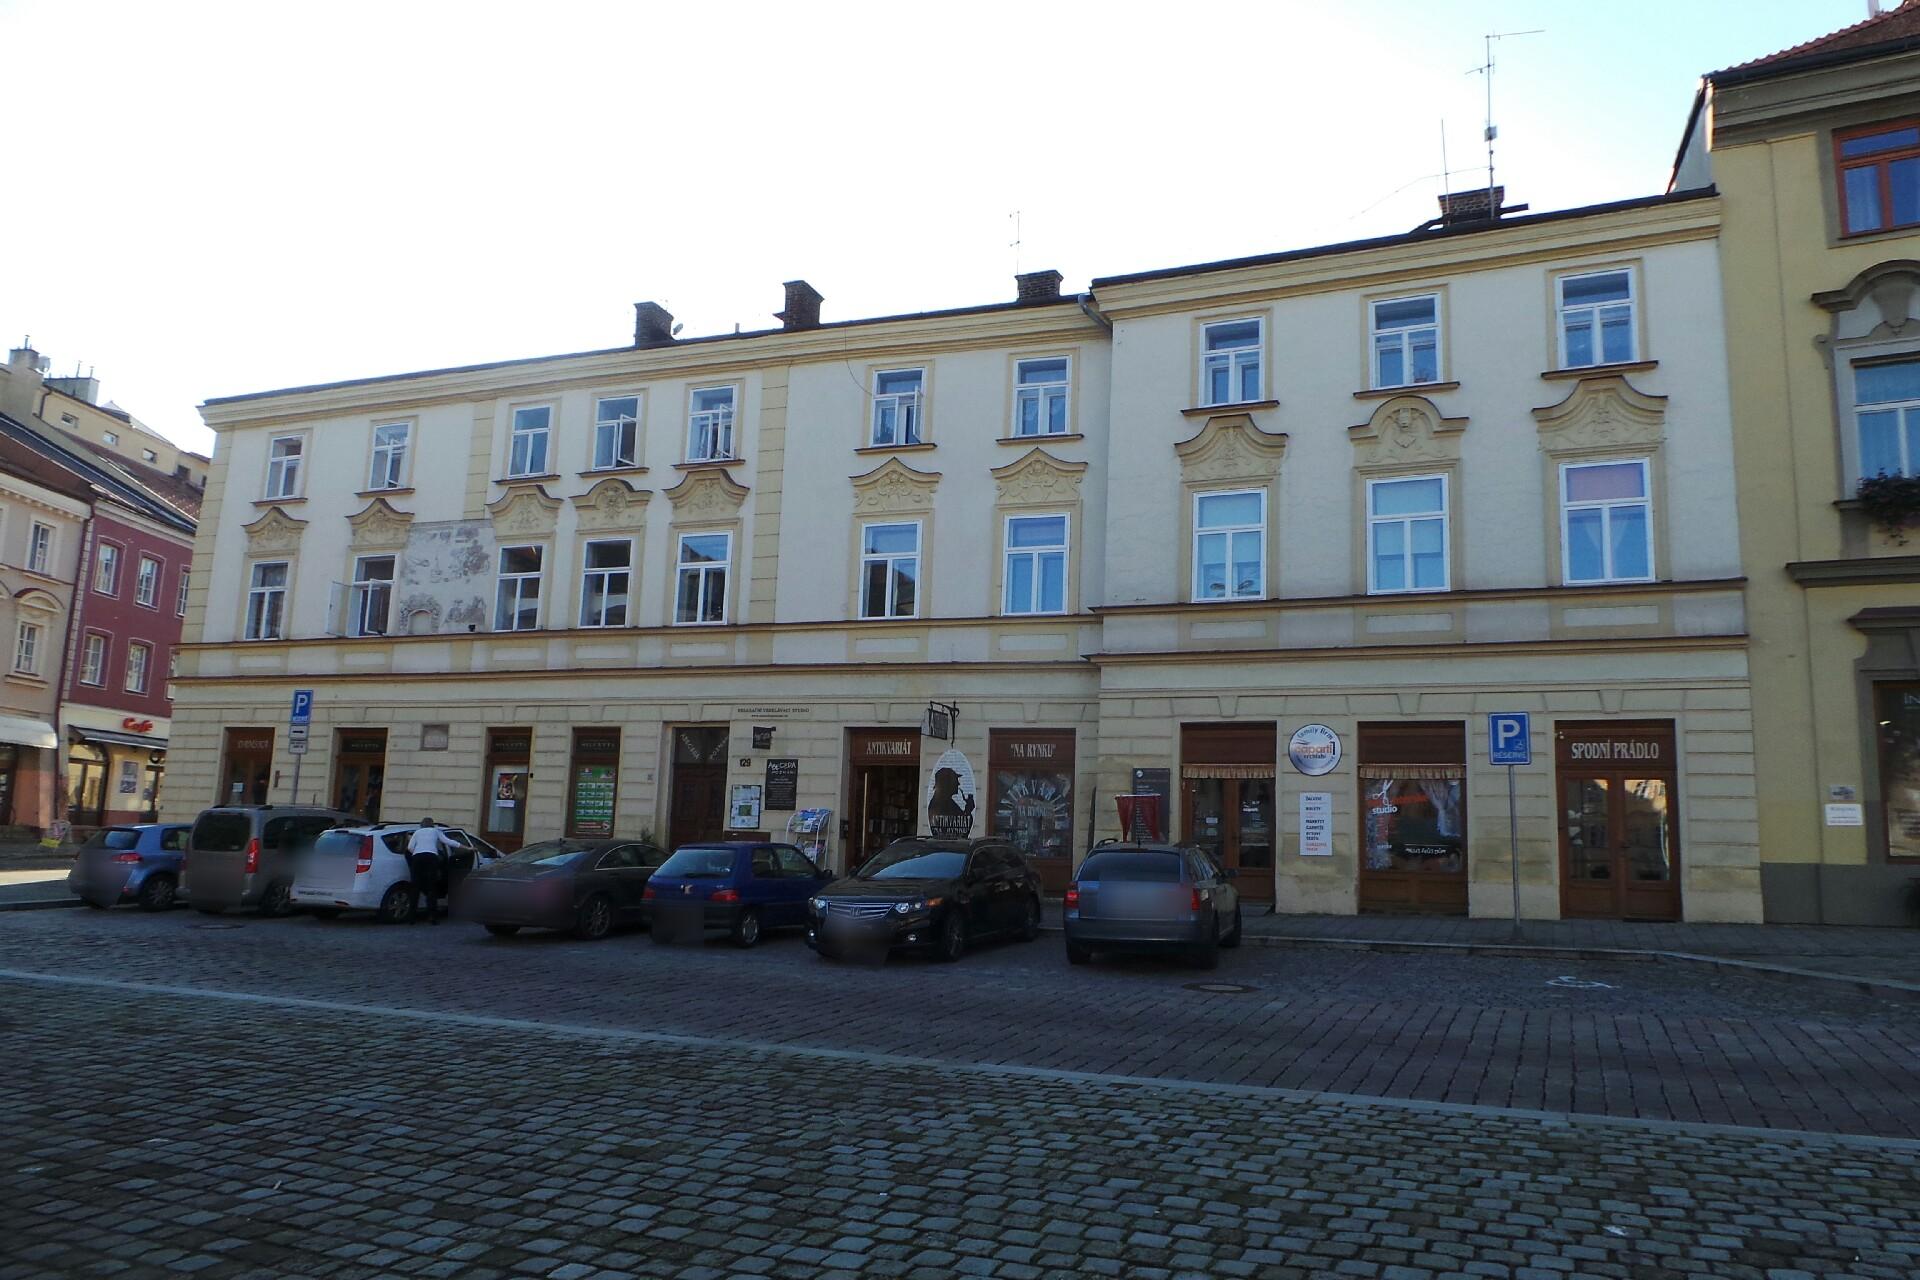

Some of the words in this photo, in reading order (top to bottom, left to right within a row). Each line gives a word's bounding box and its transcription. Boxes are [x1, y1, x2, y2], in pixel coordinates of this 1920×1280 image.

[296, 695, 308, 713] P
[1498, 719, 1520, 748] P
[866, 738, 912, 755] ANTIKVARIÁT
[1571, 739, 1611, 759] SPODNÍ
[1613, 739, 1660, 759] PRÁDLO
[739, 758, 751, 767] 129
[1372, 806, 1398, 815] studio
